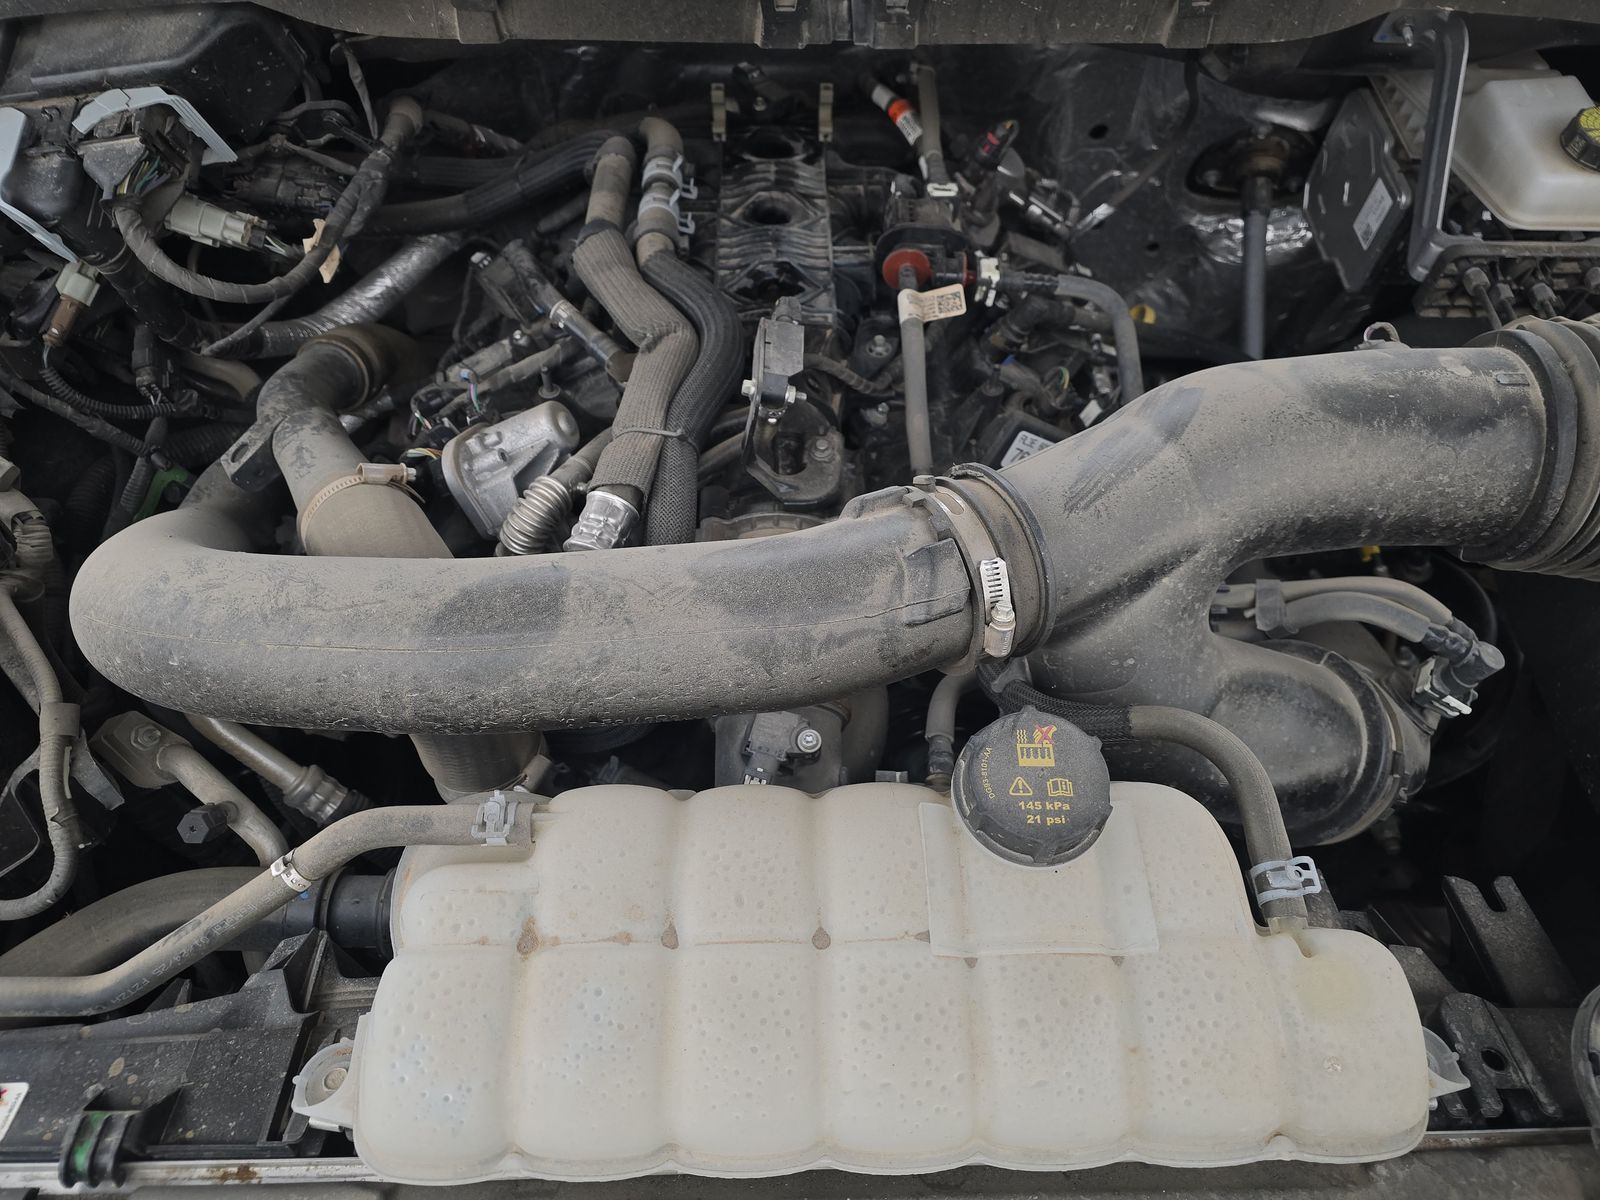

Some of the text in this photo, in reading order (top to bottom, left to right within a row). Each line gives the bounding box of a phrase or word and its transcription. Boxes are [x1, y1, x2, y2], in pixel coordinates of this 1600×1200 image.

[1018, 801, 1070, 811] 145 kPa
[1026, 815, 1066, 826] 21 psi
